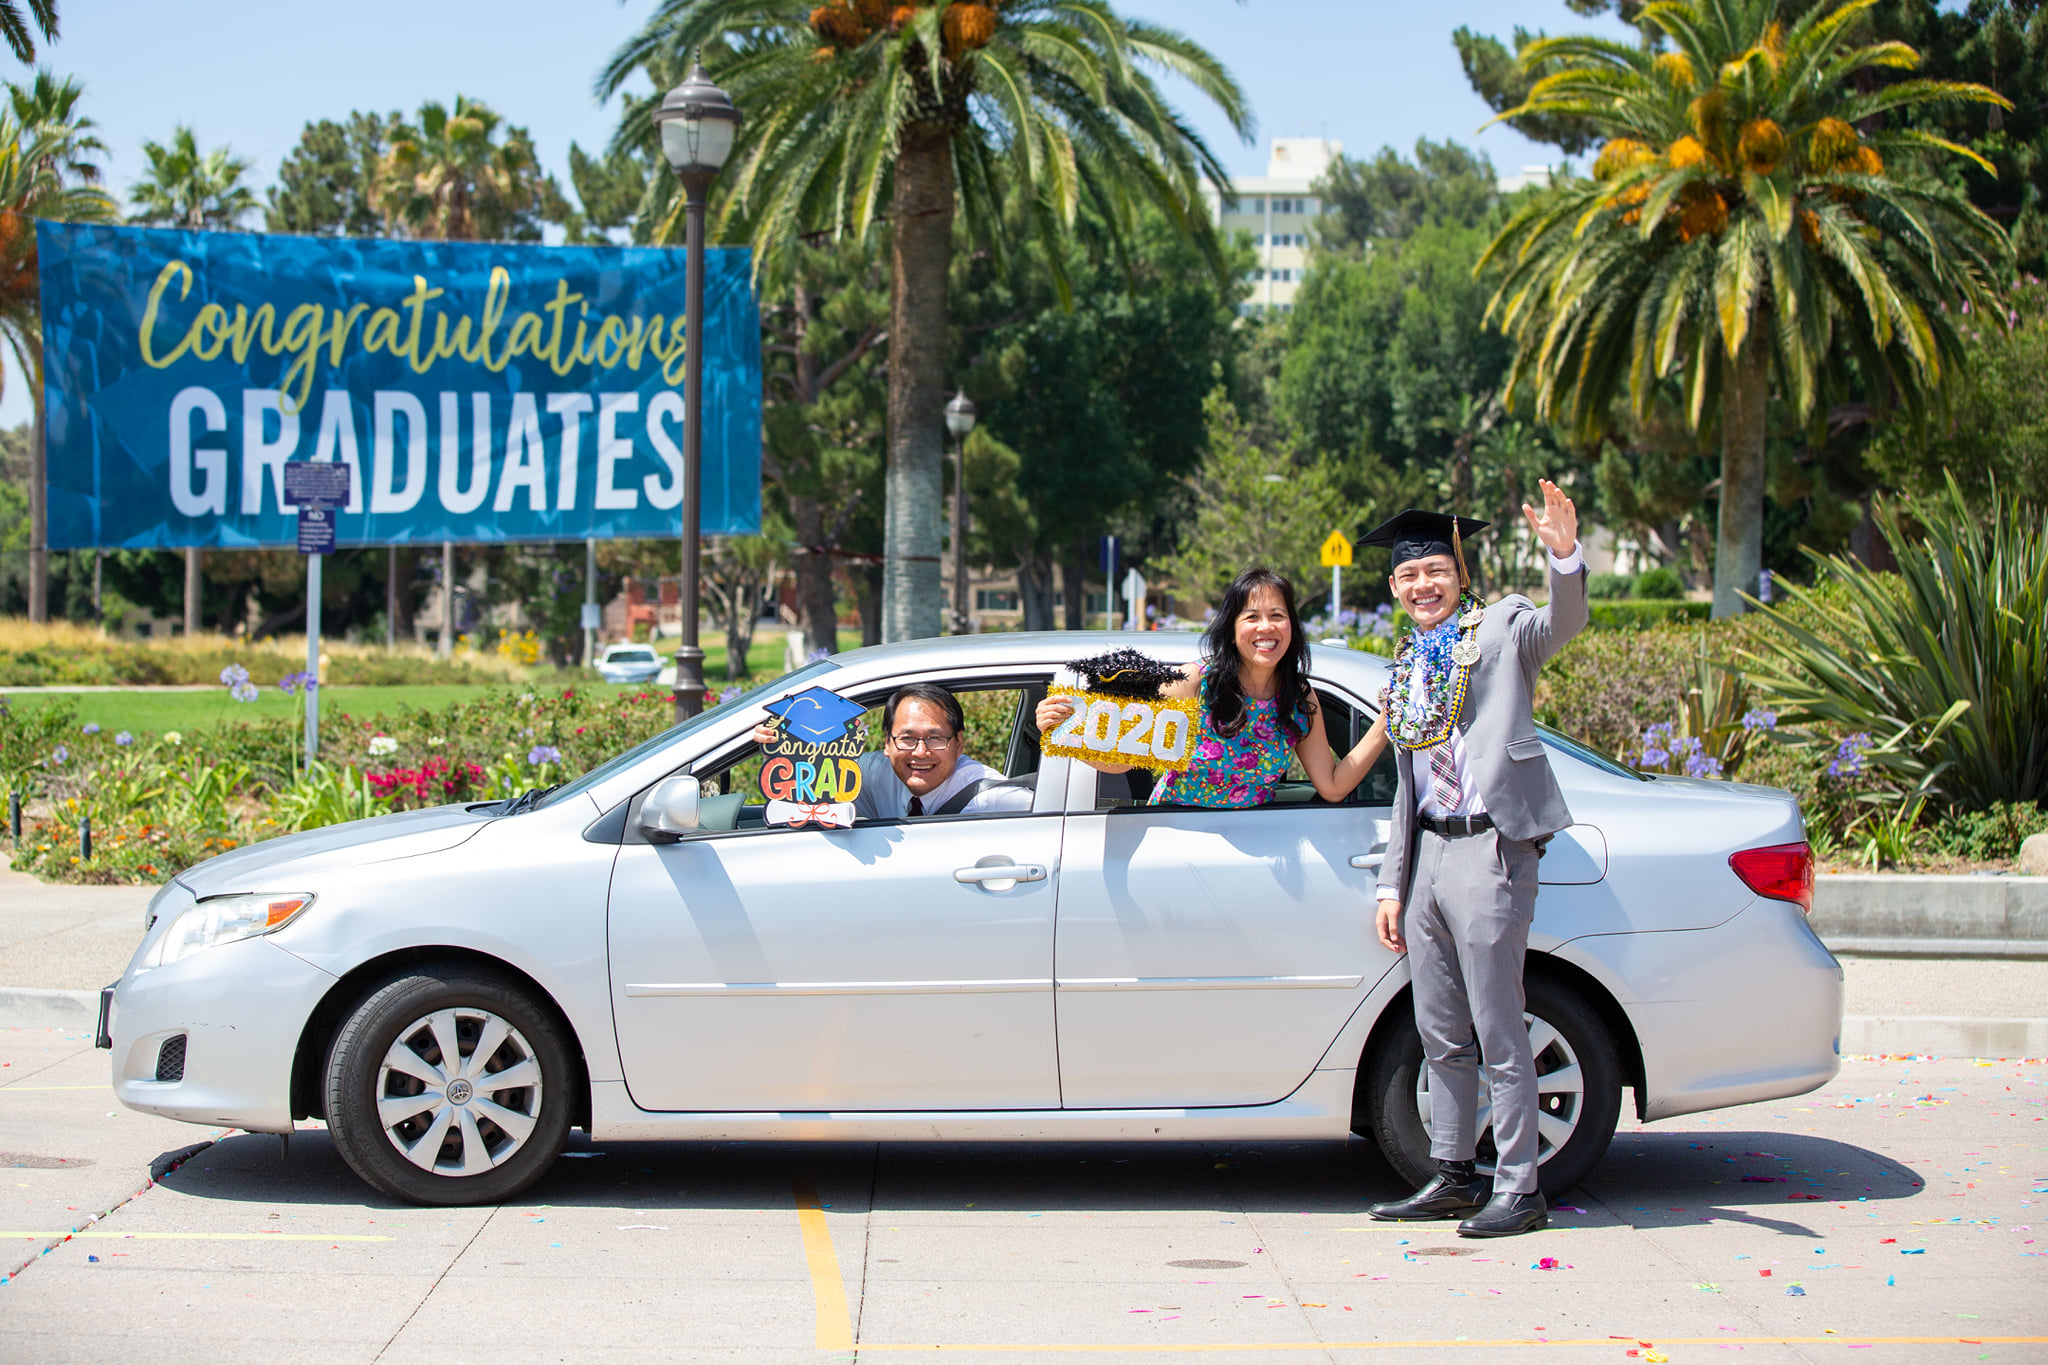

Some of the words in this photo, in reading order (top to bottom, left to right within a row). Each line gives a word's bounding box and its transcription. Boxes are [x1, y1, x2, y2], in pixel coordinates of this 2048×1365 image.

[139, 259, 687, 416] Congratulations
[169, 386, 686, 517] GRADUATES
[308, 510, 325, 521] NO
[763, 729, 865, 764] Congrats
[1051, 695, 1189, 762] 2020
[760, 757, 862, 802] GRAD
